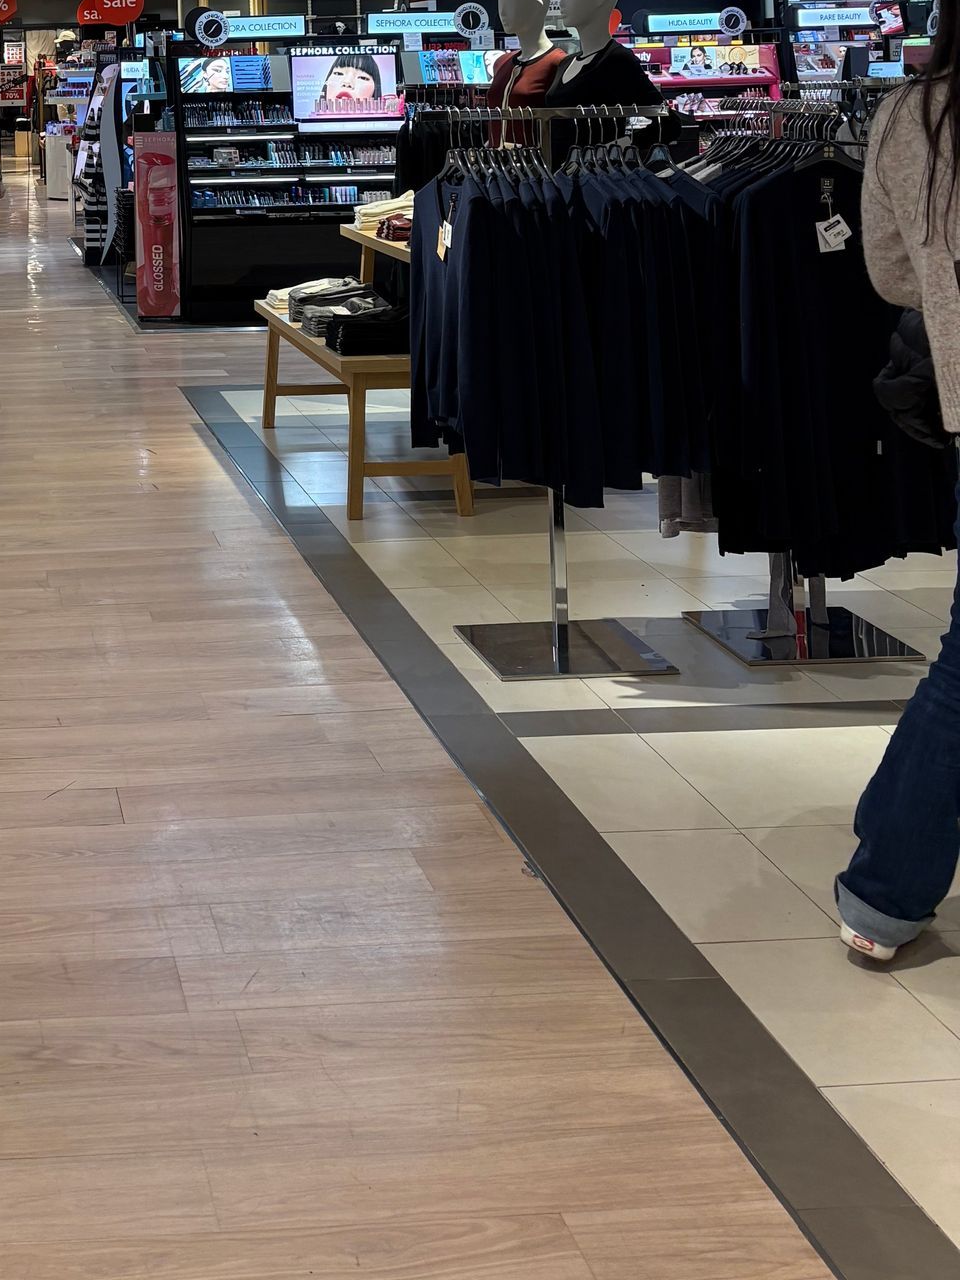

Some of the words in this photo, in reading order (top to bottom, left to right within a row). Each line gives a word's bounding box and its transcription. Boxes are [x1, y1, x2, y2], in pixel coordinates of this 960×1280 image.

[248, 21, 297, 32] COLLECTION
[375, 19, 413, 28] SEPHORA
[414, 18, 455, 27] COLLECTIO
[668, 19, 688, 27] HUDA
[688, 18, 713, 26] BEAUTY
[290, 47, 334, 56] SEPHORA
[335, 45, 397, 55] COLLECTION
[152, 244, 164, 292] GLOSSED
